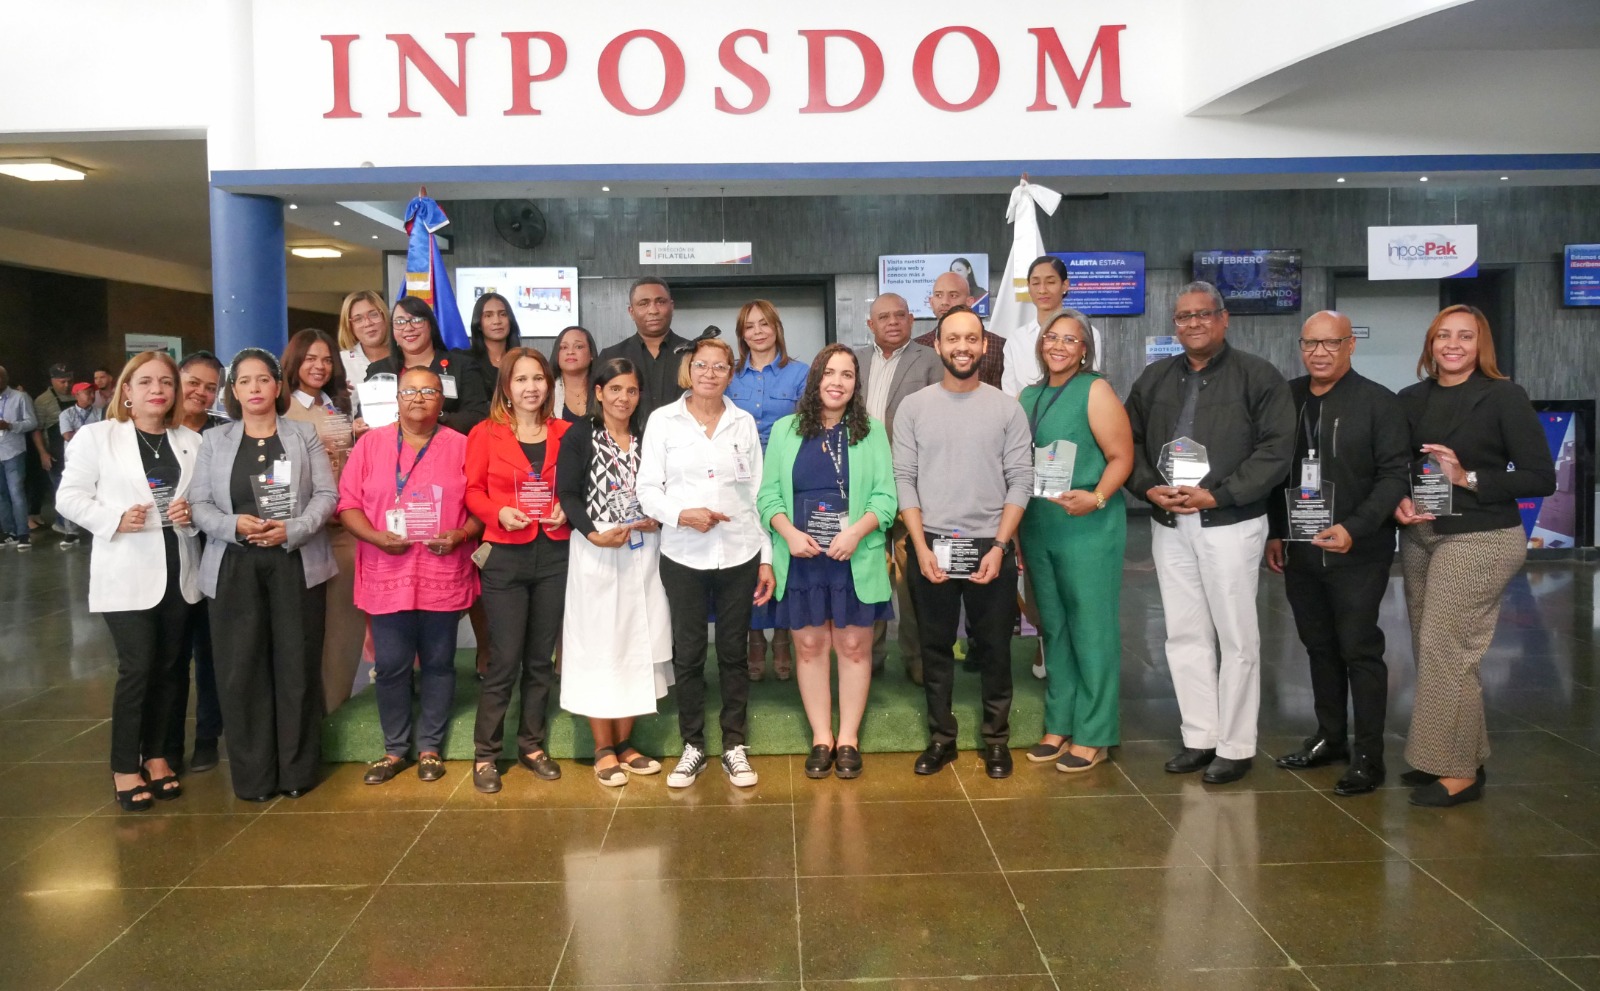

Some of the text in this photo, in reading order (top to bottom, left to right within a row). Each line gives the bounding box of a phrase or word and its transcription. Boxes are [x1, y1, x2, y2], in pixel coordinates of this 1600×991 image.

[320, 24, 1131, 119] INPOSDOM
[1388, 241, 1457, 260] InposPak
[1201, 256, 1263, 265] EN FEBRERO
[1230, 289, 1293, 298] EXPORTANDO
